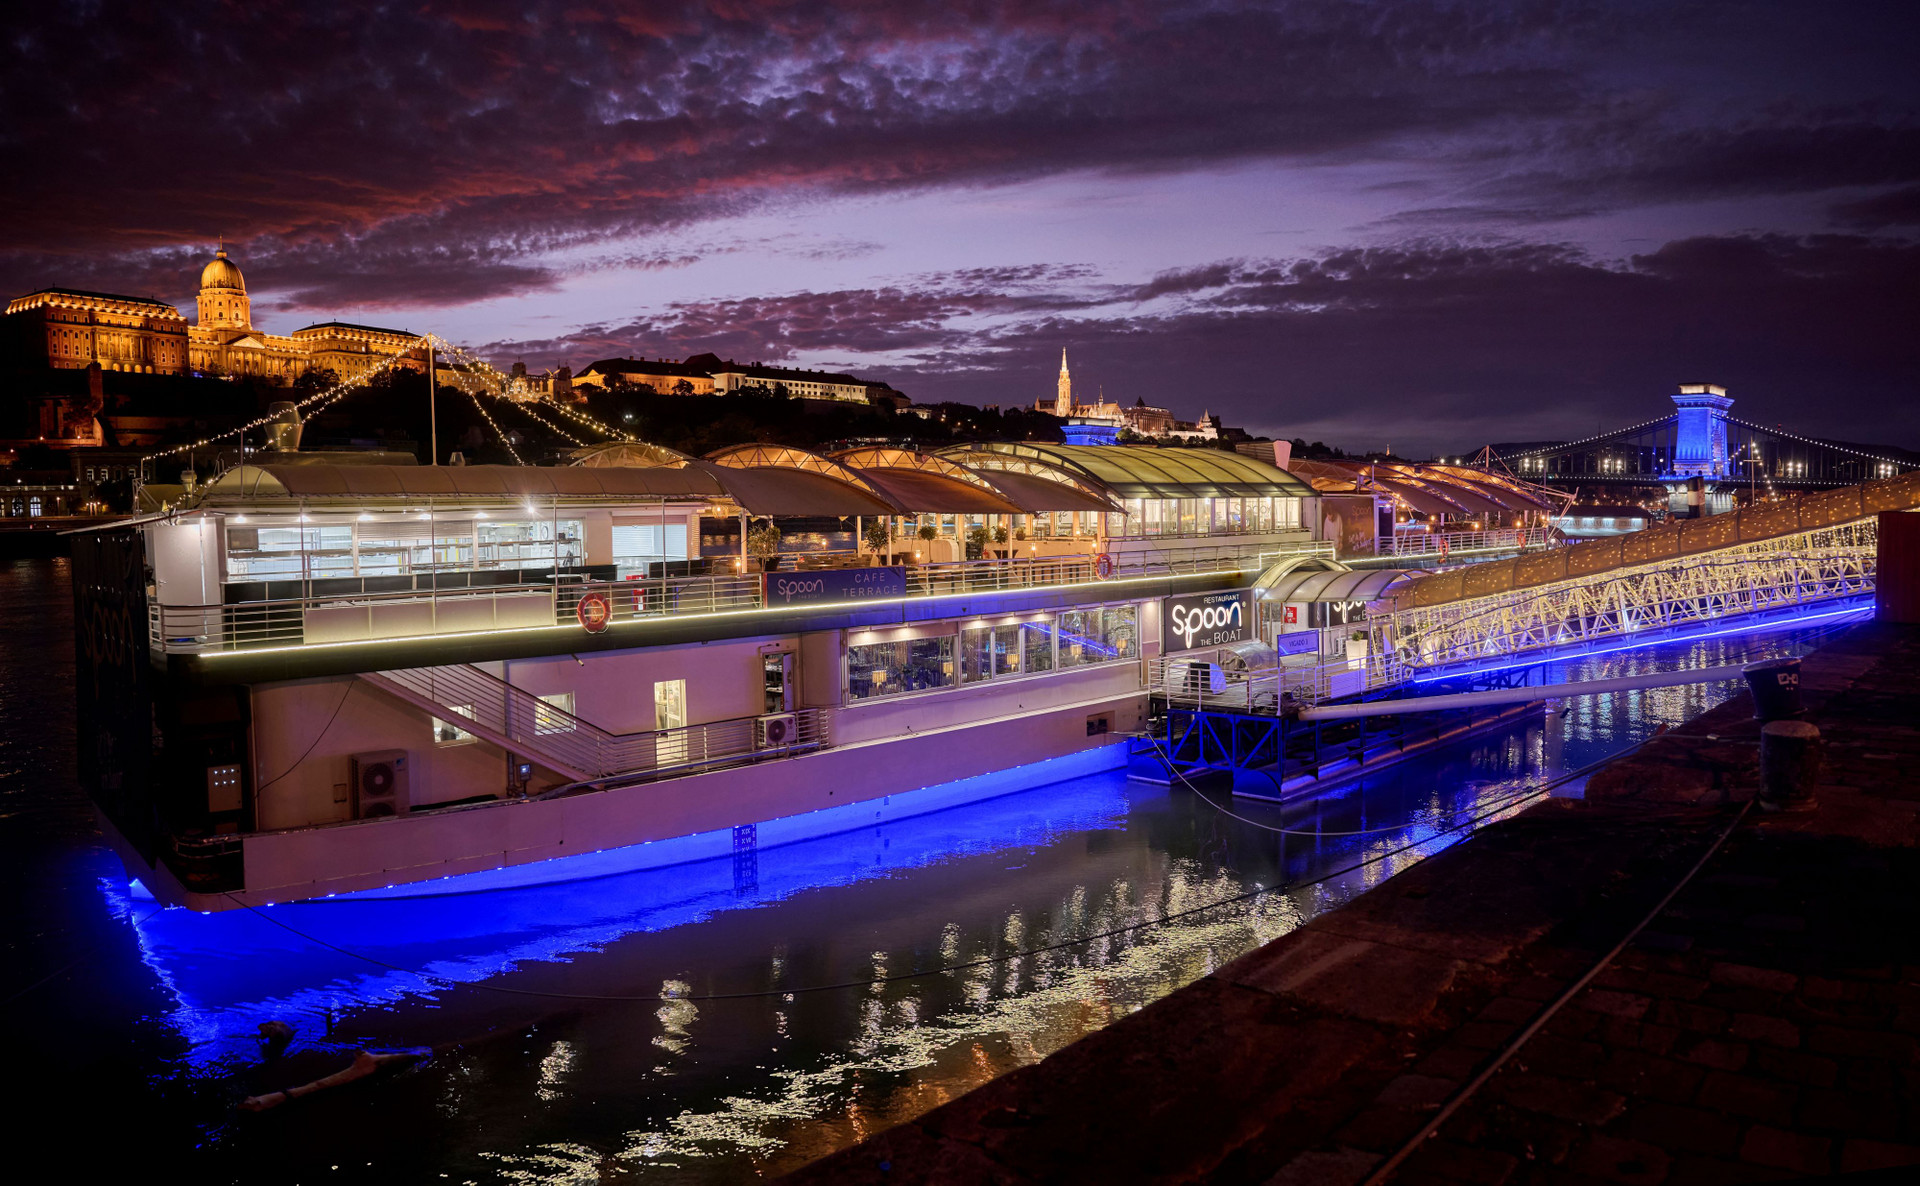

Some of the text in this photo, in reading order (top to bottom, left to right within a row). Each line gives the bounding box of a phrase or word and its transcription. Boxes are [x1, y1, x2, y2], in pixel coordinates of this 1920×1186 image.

[855, 572, 885, 583] CAFE
[777, 578, 824, 602] Spoon
[842, 585, 898, 597] TERRACE
[1203, 594, 1240, 604] RESTAURANT
[1172, 601, 1242, 649] Spoon
[1201, 629, 1242, 646] THE BOAT
